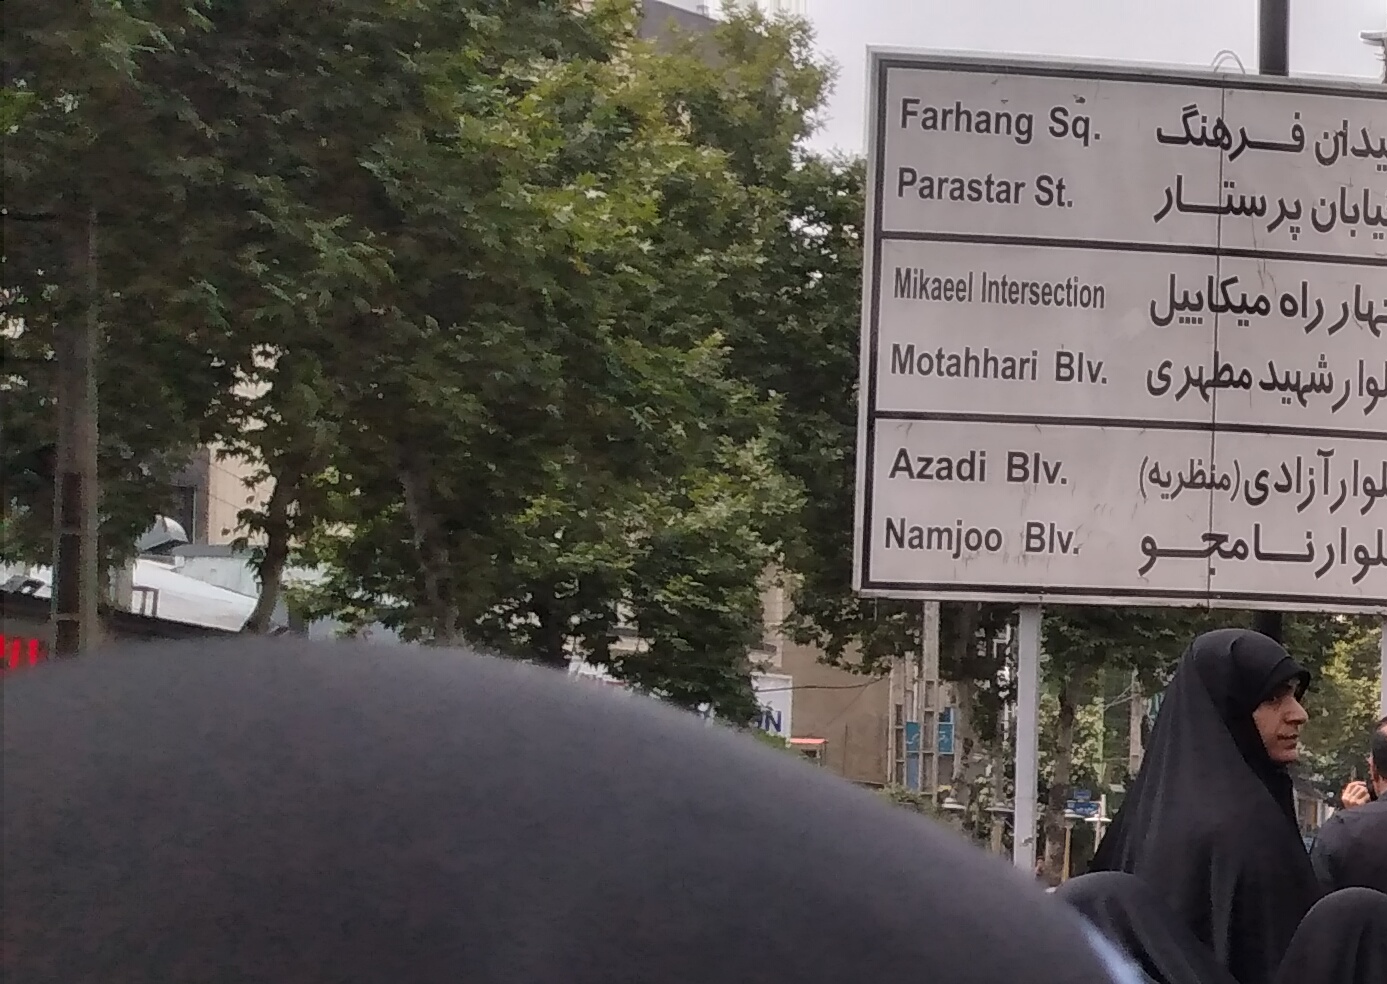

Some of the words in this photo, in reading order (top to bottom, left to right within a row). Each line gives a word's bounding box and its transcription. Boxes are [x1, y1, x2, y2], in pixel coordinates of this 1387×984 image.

[901, 97, 1034, 145] Farhang
[1048, 105, 1101, 148] Sq.
[1156, 103, 1305, 162] فرهنگ
[897, 166, 1026, 205] Parastar
[1034, 174, 1073, 208] St.
[1153, 174, 1303, 242] پرستار
[893, 266, 974, 303] Mikaeel
[980, 270, 1105, 309] Intersection
[1149, 272, 1271, 328] میکاییل
[1279, 280, 1324, 335] راه
[890, 342, 1039, 382] Motahhari
[1055, 350, 1108, 385] Blv.
[1146, 349, 1253, 402] مطهری
[1258, 353, 1334, 408] شهید
[887, 446, 987, 483] Azadi
[1006, 450, 1068, 486] Blv.
[1138, 454, 1241, 503] (منظریه)
[1243, 447, 1336, 514] آزادی
[884, 516, 1004, 560] Namjoo
[1024, 520, 1080, 556] Blv.
[1137, 522, 1316, 578] نامجو
